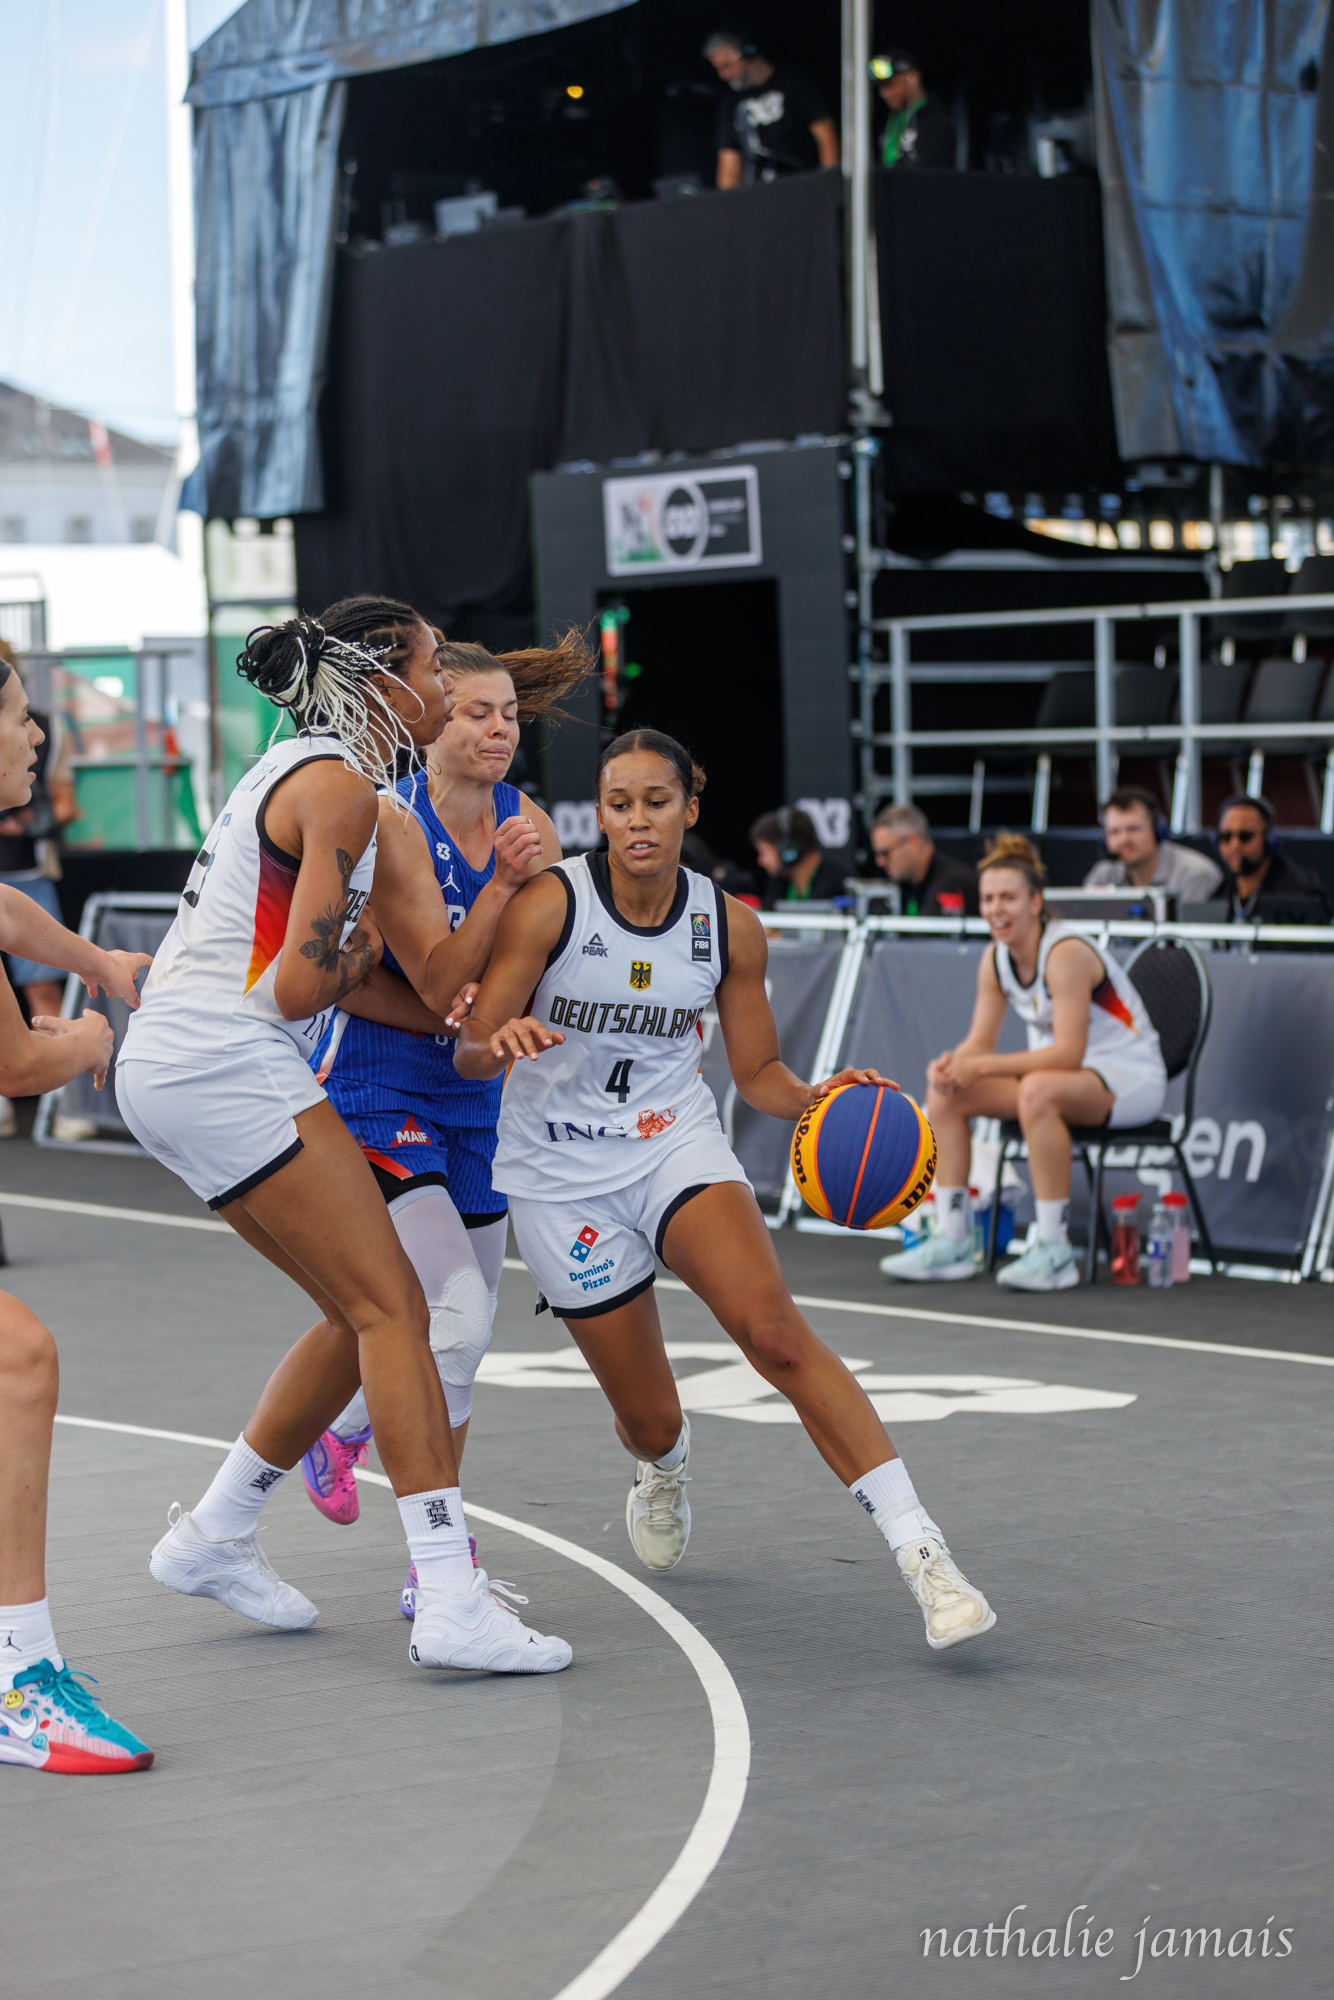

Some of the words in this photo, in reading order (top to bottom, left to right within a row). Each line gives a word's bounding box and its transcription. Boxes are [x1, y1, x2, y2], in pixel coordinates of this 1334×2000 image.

[582, 944, 609, 958] PEAK
[694, 940, 710, 950] FIBA
[604, 1058, 635, 1104] 4
[395, 1130, 429, 1145] MAIF
[544, 1120, 628, 1143] ING
[568, 1257, 615, 1283] Domino's
[581, 1274, 612, 1292] Pizza
[423, 1498, 454, 1531] PEAK
